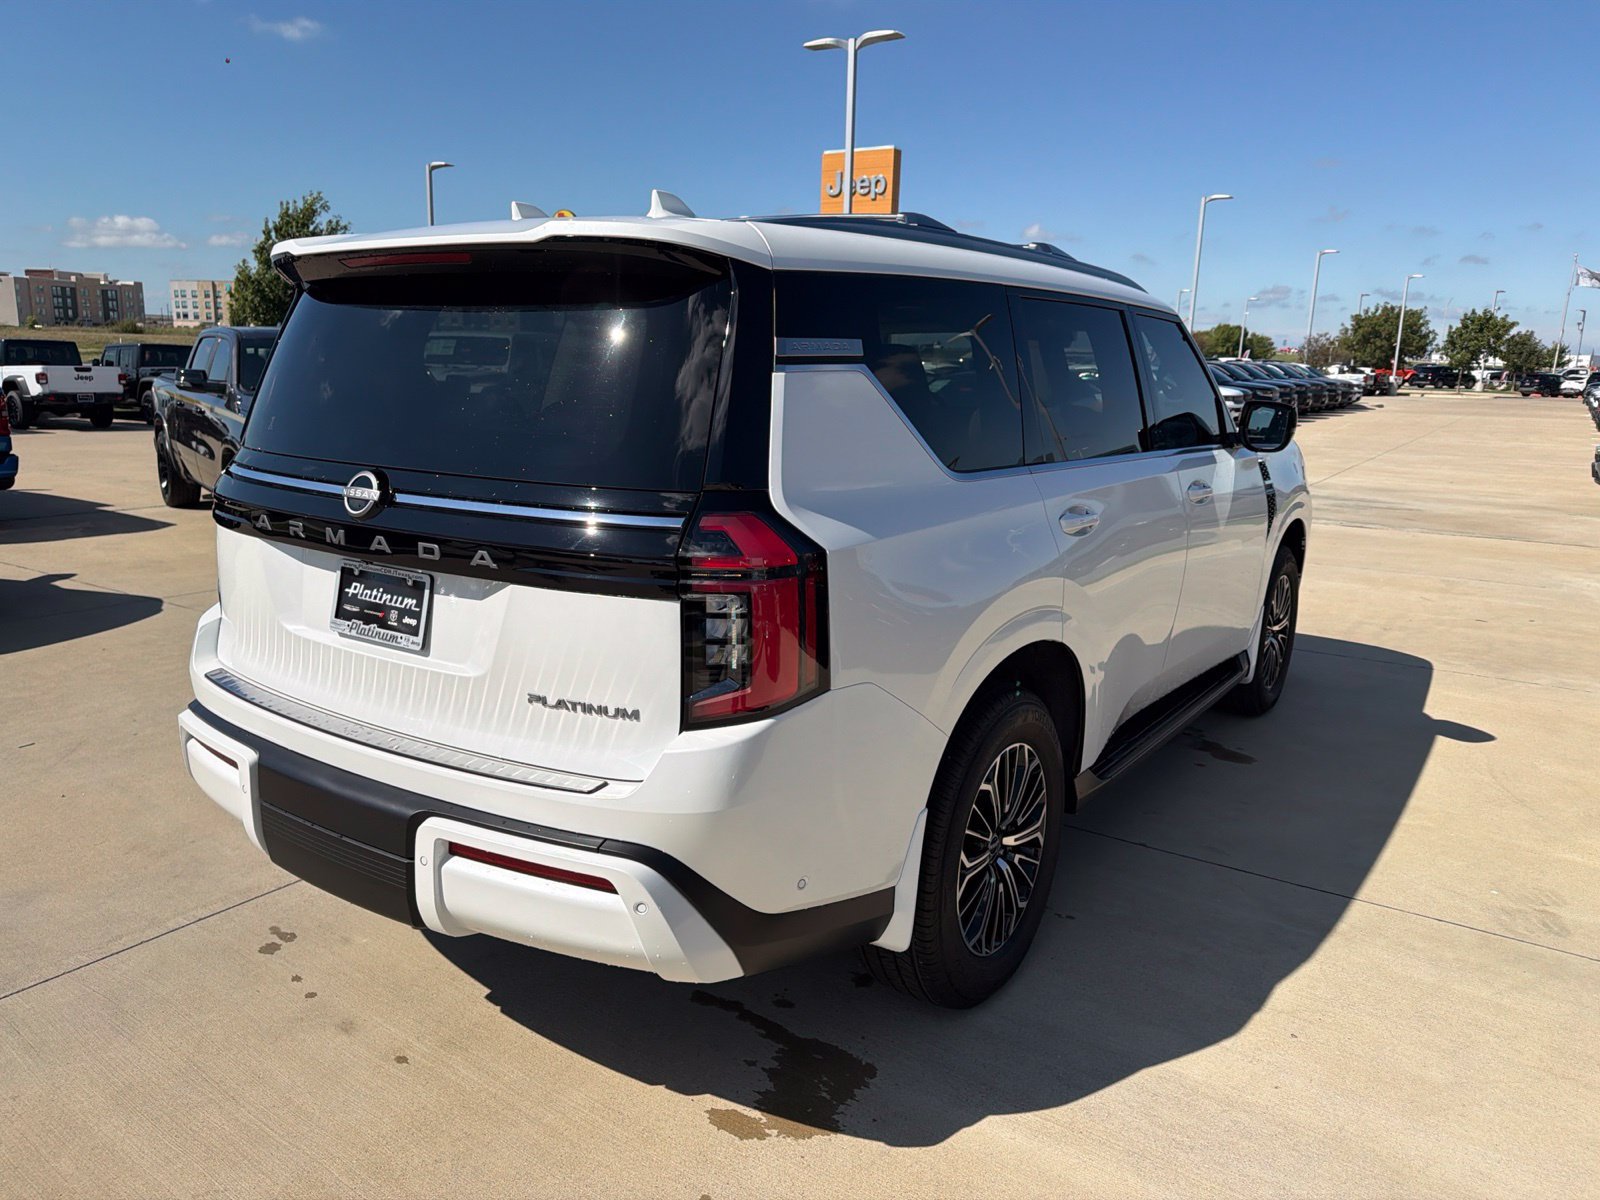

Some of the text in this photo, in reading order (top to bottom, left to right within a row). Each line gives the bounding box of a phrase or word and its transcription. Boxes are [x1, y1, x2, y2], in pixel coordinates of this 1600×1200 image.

[826, 170, 888, 201] Jep
[792, 342, 850, 351] ARMADA
[343, 487, 380, 501] NISSAN
[255, 514, 498, 569] ARMADA
[344, 582, 420, 611] Platinum
[349, 620, 402, 644] Platinum
[403, 616, 417, 626] Jeep
[527, 693, 640, 722] PLATINUM
